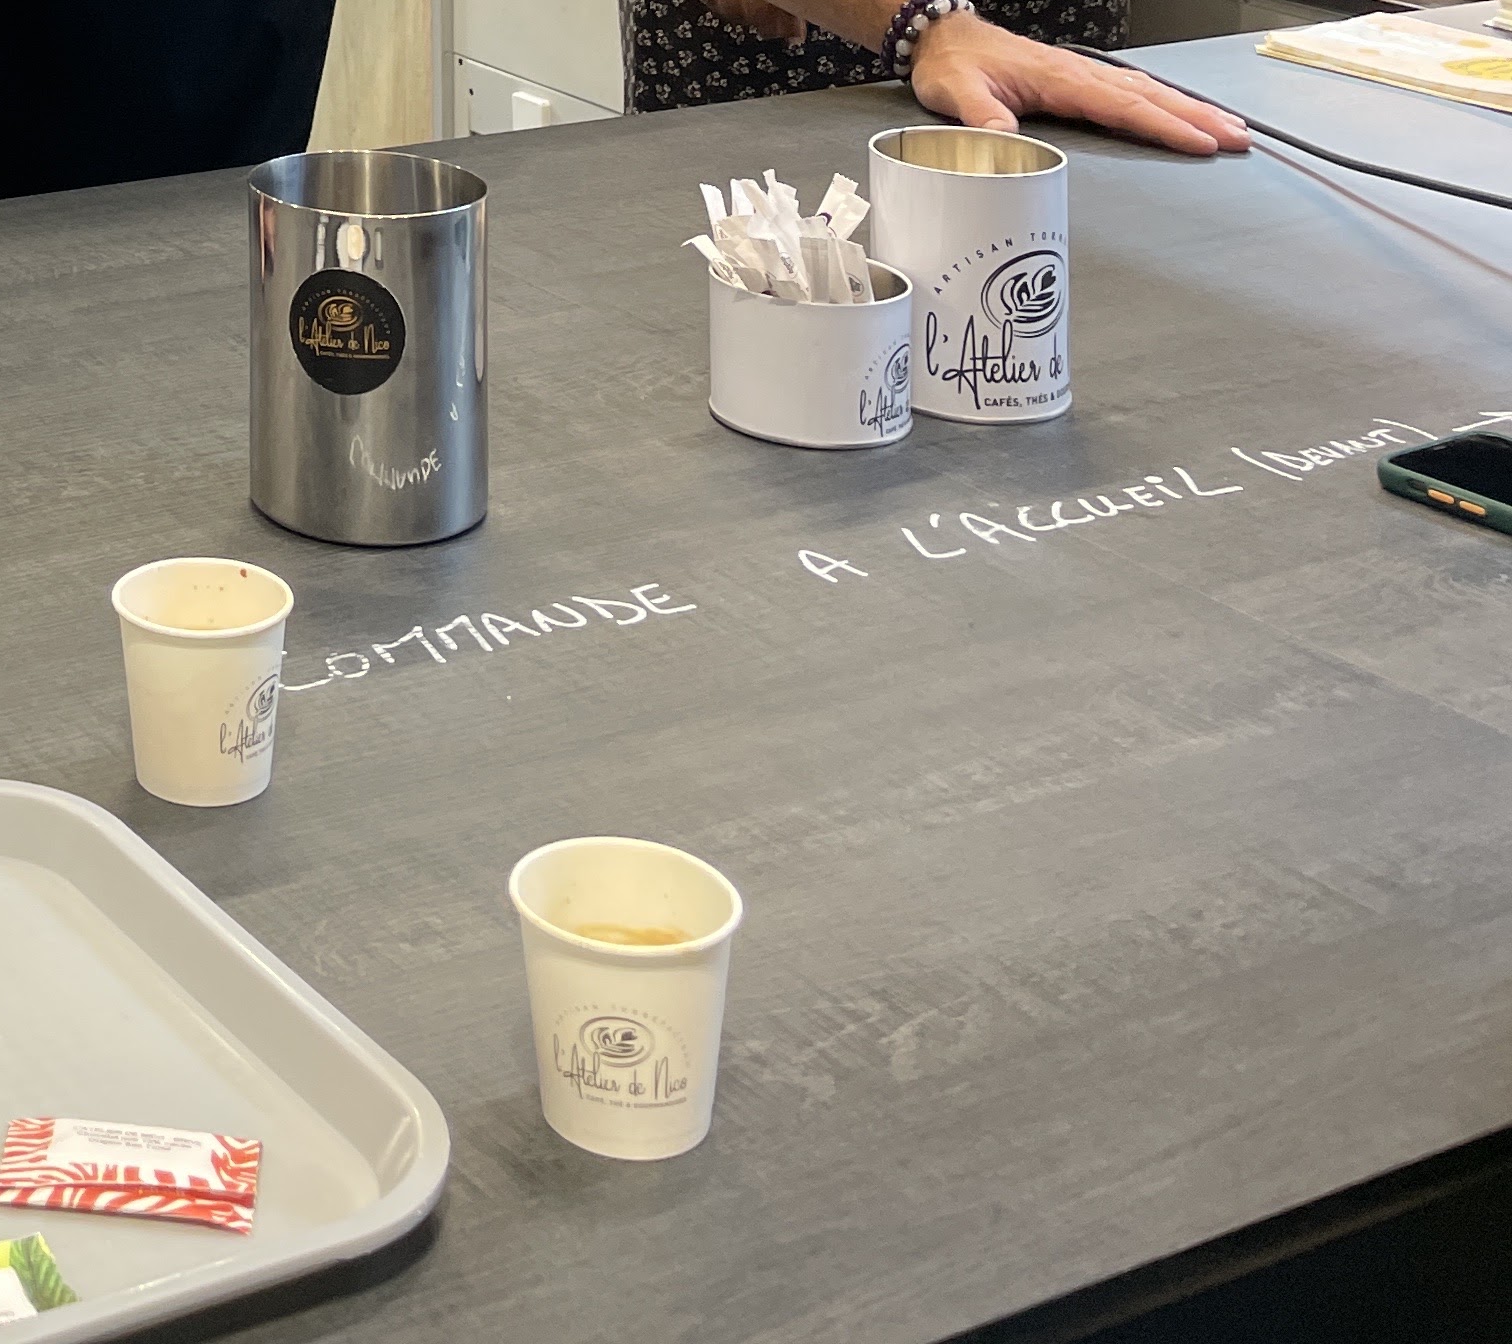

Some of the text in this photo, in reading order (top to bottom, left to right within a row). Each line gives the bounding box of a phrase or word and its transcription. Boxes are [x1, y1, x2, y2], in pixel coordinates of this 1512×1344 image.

[933, 237, 1014, 296] ARTISAN
[925, 310, 1063, 411] l'Atelier de
[1026, 391, 1049, 406] THÉS
[654, 1055, 688, 1100] Nico
